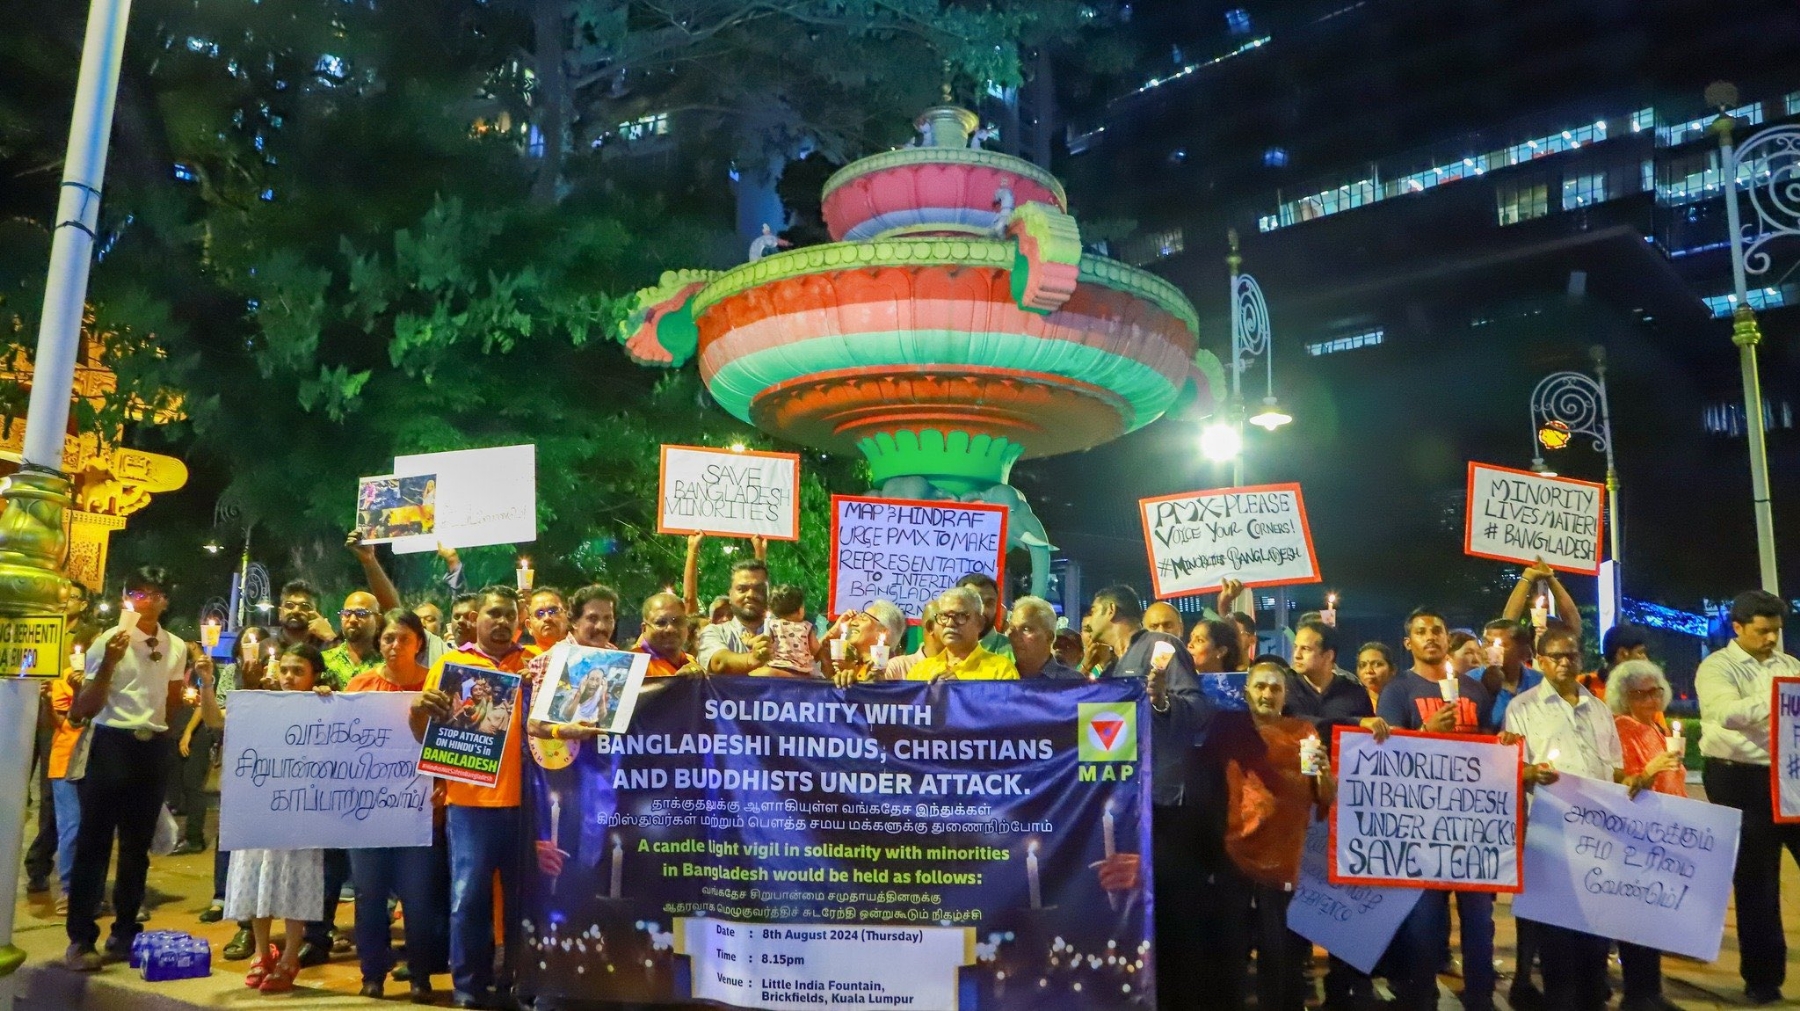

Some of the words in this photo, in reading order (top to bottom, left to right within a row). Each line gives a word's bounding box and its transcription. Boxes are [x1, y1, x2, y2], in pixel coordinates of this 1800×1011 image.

[702, 464, 761, 487] SAVE
[674, 480, 790, 506] BANGLADESH
[1491, 479, 1593, 514] MINORITY
[664, 496, 779, 521] MINORITES
[845, 502, 883, 521] MAP
[898, 507, 985, 528] HINDRAF
[1485, 499, 1541, 524] LIVES
[839, 525, 883, 548] URGE
[887, 527, 930, 546] PMX
[934, 530, 950, 547] TO
[951, 533, 998, 551] MAKE
[1155, 525, 1201, 548] VOICE
[1206, 522, 1243, 543] YOUR
[1247, 519, 1295, 539] CORNERS!
[1504, 523, 1597, 562] BANGLADESH
[839, 549, 995, 574] REPRESENTATION
[864, 570, 882, 582] TO
[892, 572, 960, 589] INTERIM
[14, 624, 58, 643] BERHENTI
[705, 699, 858, 724] SOLIDARITY
[865, 704, 932, 726] WITH
[435, 737, 447, 747] ON
[449, 740, 482, 754] HINDU'S
[483, 746, 492, 756] in
[438, 727, 459, 739] STOP
[460, 731, 494, 746] ATTACKS
[597, 734, 770, 756] BANGLADESHI
[894, 738, 1053, 761] CHRISTIANS
[422, 747, 498, 773] BANGLADESH
[1351, 749, 1481, 782] MINORITIES
[613, 768, 667, 789] AND
[675, 768, 813, 792] BUDDHISTS
[821, 771, 912, 794] UNDER
[919, 774, 1031, 796] ATTACK.
[1346, 779, 1376, 806] IN
[1380, 782, 1509, 815] BANGLADESH
[1355, 811, 1426, 839] UNDER
[1432, 816, 1517, 846] ATTACK!
[638, 839, 650, 852] A
[653, 839, 705, 853] candle
[708, 840, 739, 857] light
[743, 842, 780, 859] vigil
[784, 843, 800, 857] in
[804, 843, 881, 861] solidarity
[885, 846, 922, 860] with
[926, 846, 1010, 861] minorities
[1349, 838, 1422, 878] SAVE
[1428, 842, 1499, 880] TEAM
[663, 863, 678, 877] in
[683, 863, 768, 881] Bangladesh
[773, 868, 824, 882] would
[829, 869, 848, 882] be
[853, 869, 889, 884] held
[893, 872, 911, 884] as
[915, 870, 982, 885] follows:
[716, 925, 735, 938] Date
[762, 929, 782, 940] 8th
[785, 930, 827, 942] August
[830, 930, 858, 940] 2024
[861, 929, 923, 943] (Thursday)
[717, 949, 736, 962] Time
[761, 954, 804, 966] 8.15pm
[717, 973, 743, 987] Venue
[762, 979, 791, 990] Little
[795, 980, 825, 991] India
[828, 981, 885, 993] Fountain,
[762, 991, 828, 1005] Brickfields,
[832, 993, 865, 1004] Kuala
[869, 994, 914, 1006] Lumpur
